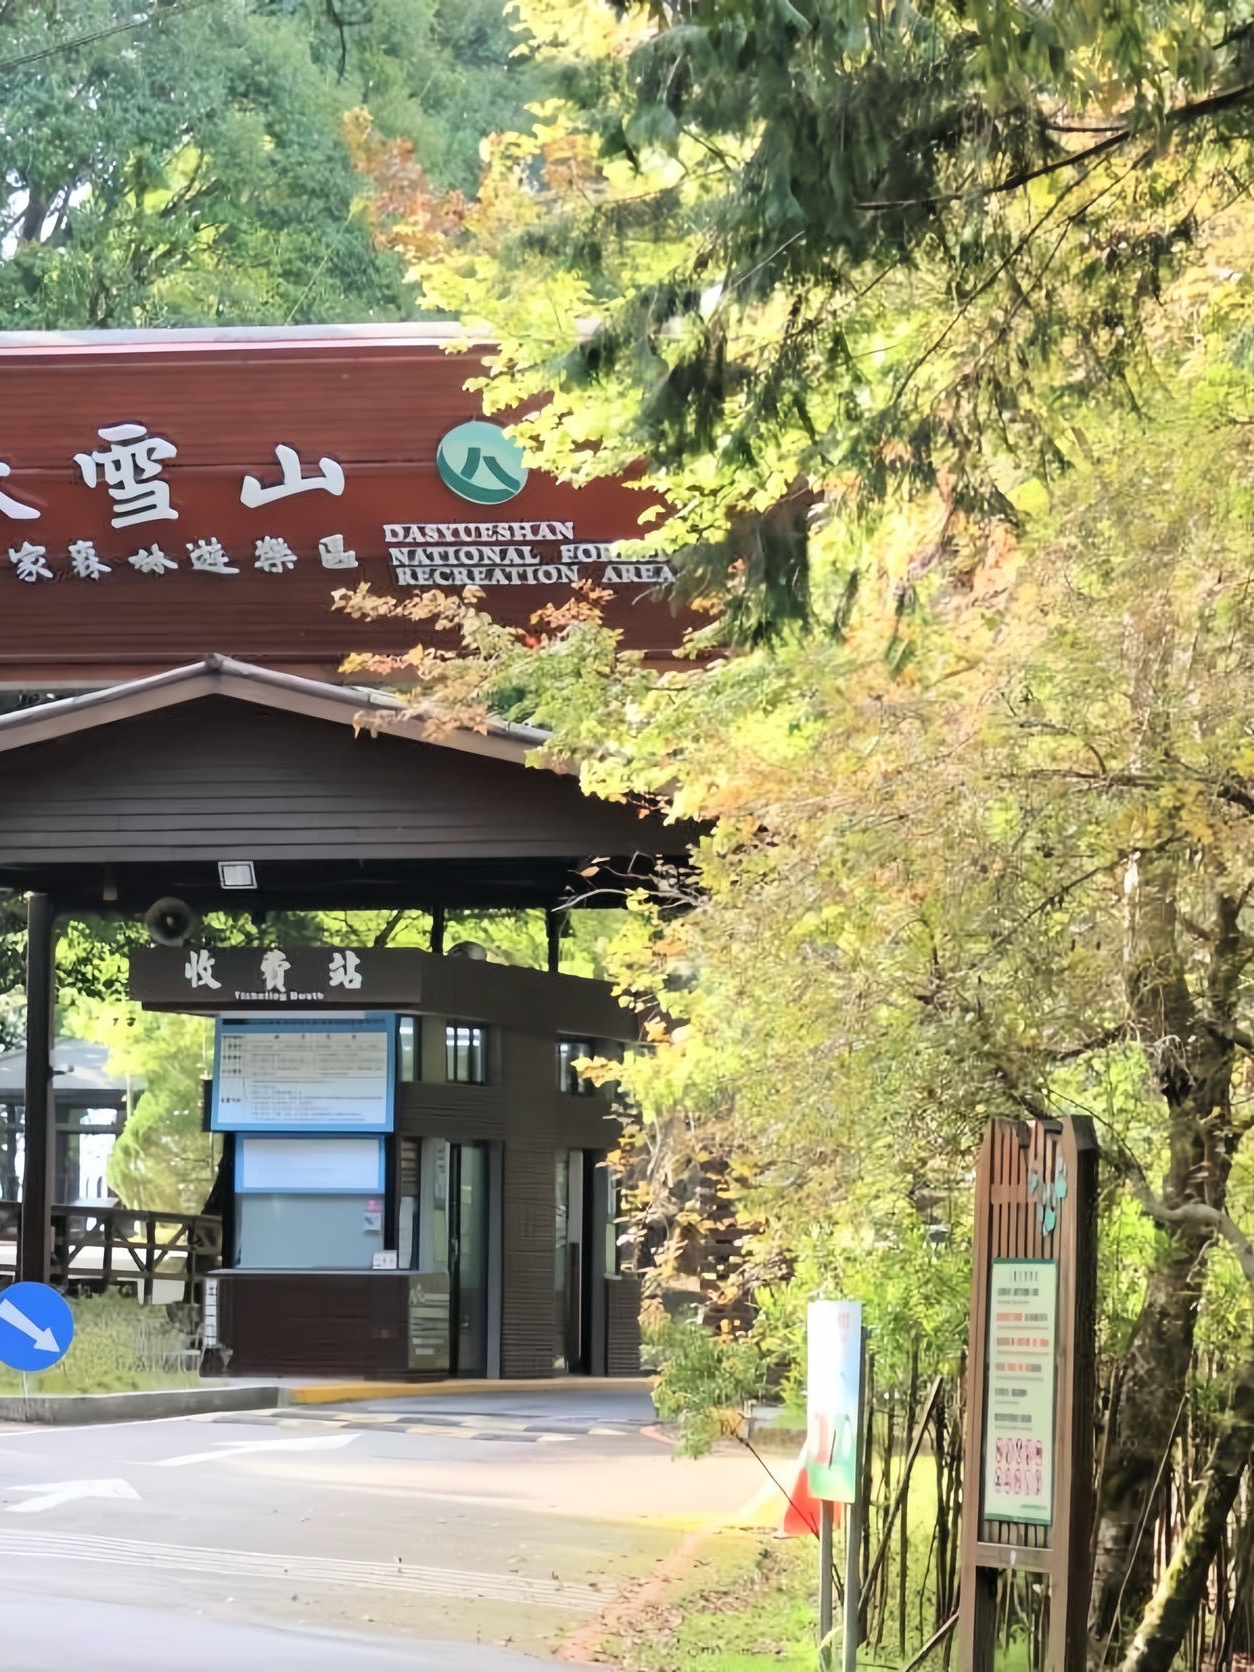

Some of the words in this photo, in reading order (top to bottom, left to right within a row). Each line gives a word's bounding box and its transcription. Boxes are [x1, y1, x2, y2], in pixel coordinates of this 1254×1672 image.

[383, 521, 574, 543] DASYUESHAN
[388, 545, 541, 566] NATIONAL
[560, 543, 669, 563] FOR
[396, 564, 579, 586] RECREATION
[602, 564, 676, 583] AREA
[184, 948, 363, 993] 收費站
